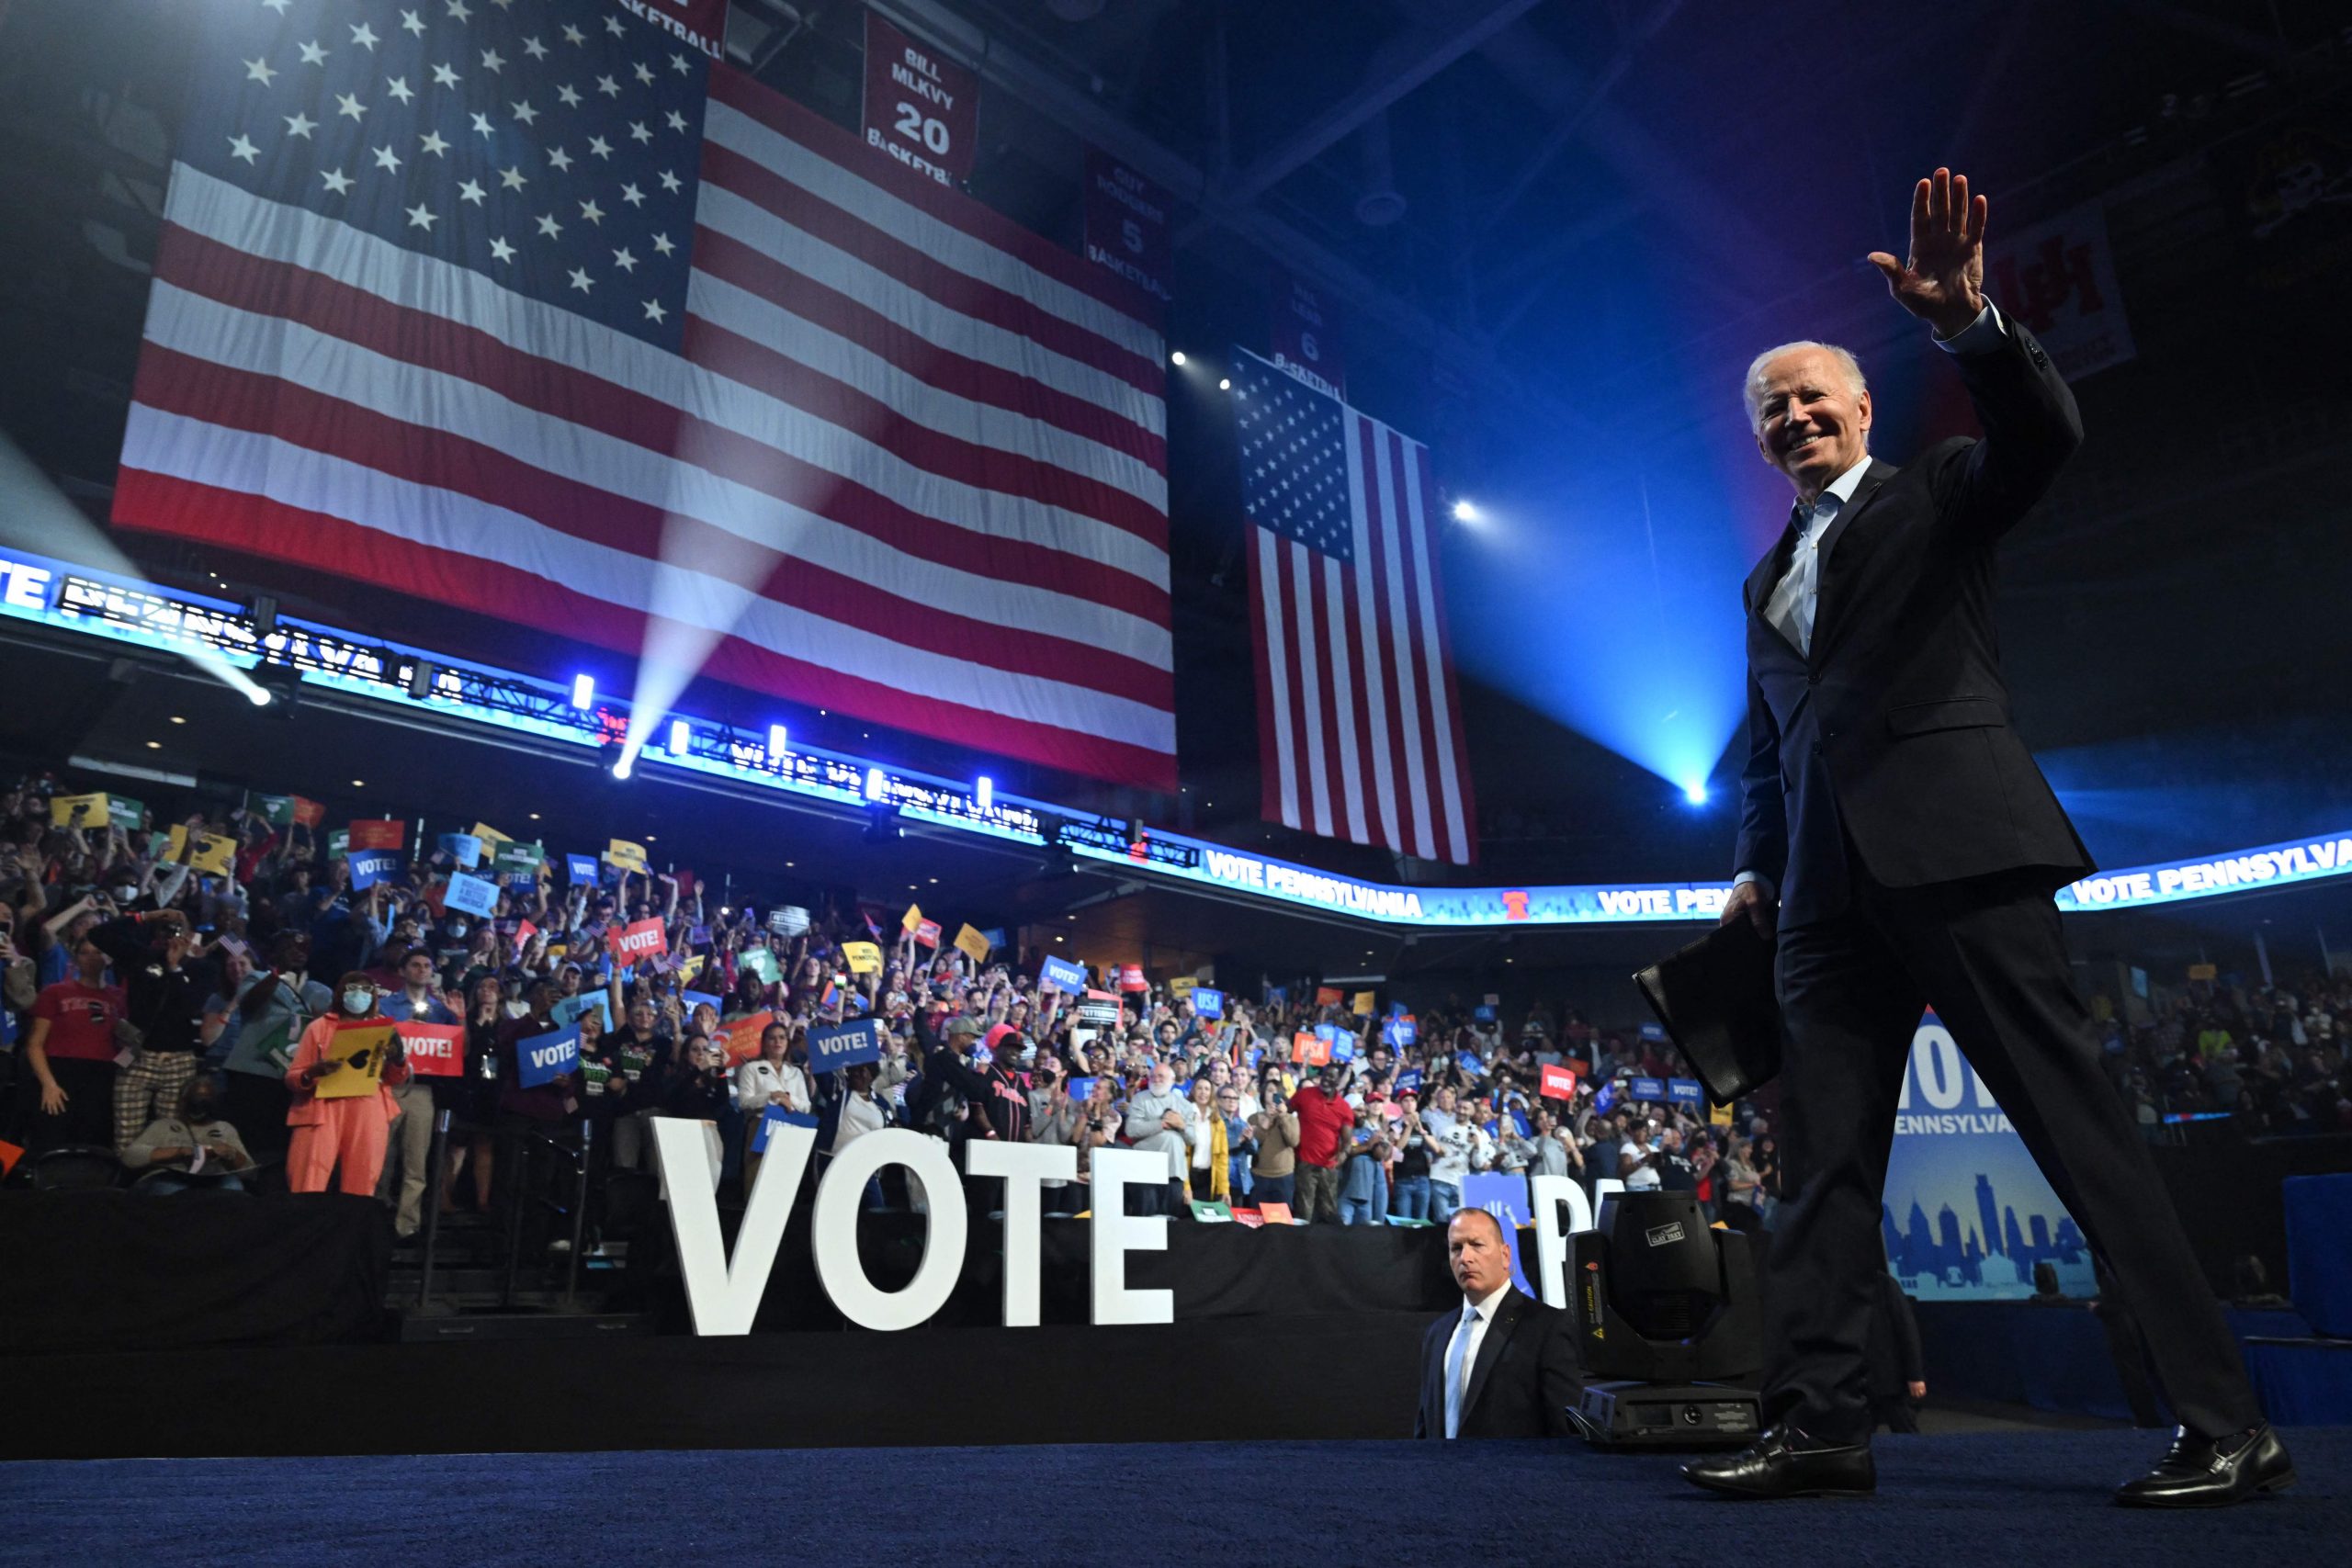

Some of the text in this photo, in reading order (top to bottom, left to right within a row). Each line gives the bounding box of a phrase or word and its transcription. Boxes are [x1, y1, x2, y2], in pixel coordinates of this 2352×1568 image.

[905, 47, 941, 83] BILL
[892, 62, 954, 110] MLKVY
[894, 101, 950, 156] 20
[1123, 219, 1143, 254] 5
[1301, 332, 1319, 361] 6
[356, 857, 397, 876] VOTE!
[571, 862, 596, 876] VOTE!
[1205, 850, 1424, 918] VOTE PENNSYLVANIA
[2072, 873, 2154, 905] VOTE
[1598, 889, 1673, 916] VOTE
[618, 929, 660, 953] VOTE!
[1048, 964, 1080, 985] VOTE!
[1197, 992, 1219, 1012] USA
[401, 1036, 453, 1058] VOTE!
[530, 1038, 576, 1068] VOTE!
[818, 1032, 868, 1055] VOTE!
[1300, 1039, 1325, 1060] USA
[1546, 1074, 1572, 1090] VOTE!
[1673, 1084, 1698, 1097] VOTE!
[1894, 1114, 2018, 1134] ENNSYLVA
[651, 1116, 1174, 1337] VOTE
